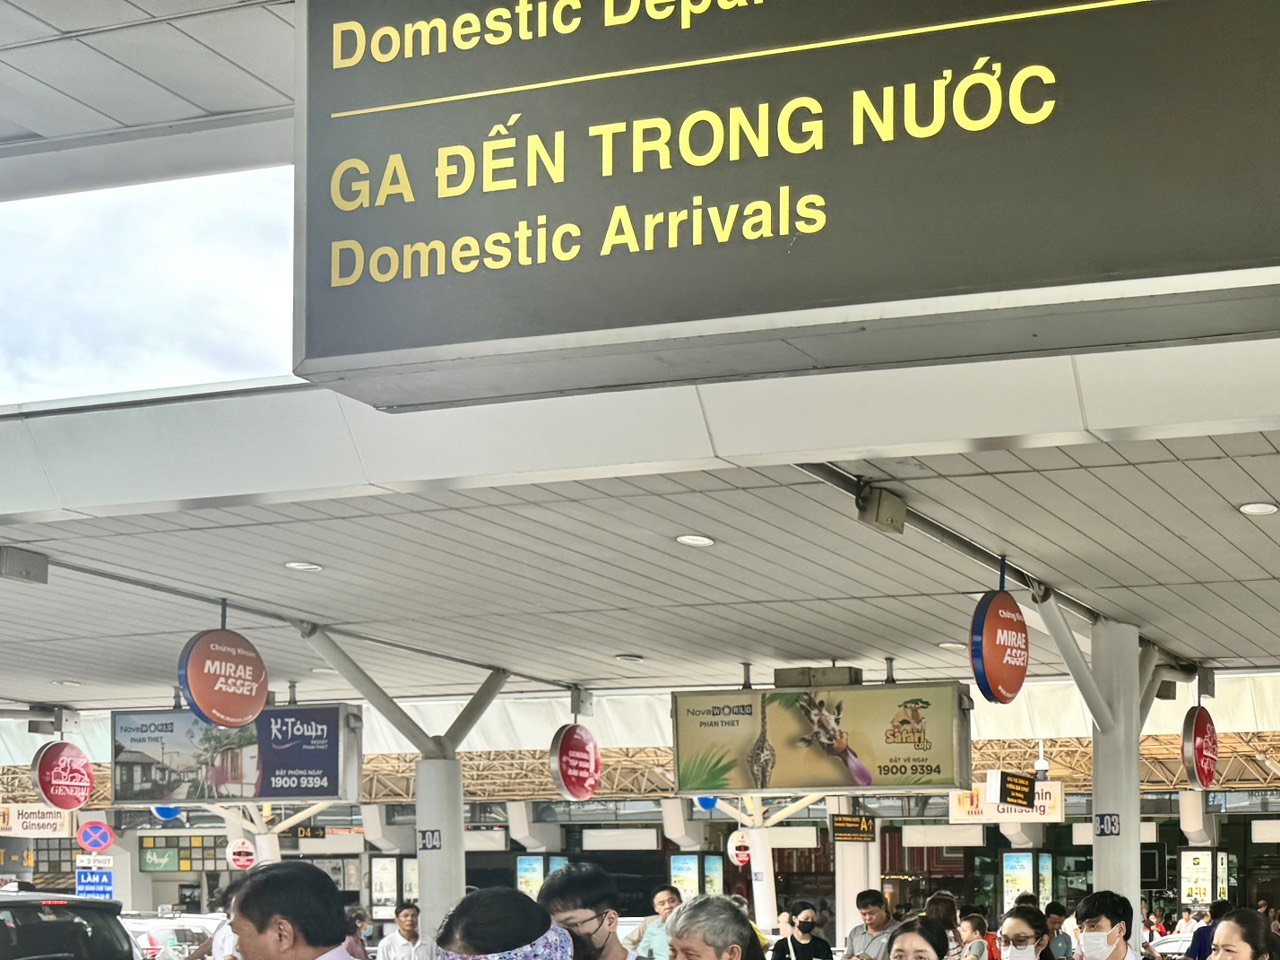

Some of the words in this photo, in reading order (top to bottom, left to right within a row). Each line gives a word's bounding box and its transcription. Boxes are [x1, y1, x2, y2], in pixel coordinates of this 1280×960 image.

[332, 0, 582, 70] Domestic
[330, 153, 415, 212] GA
[435, 113, 565, 199] ĐẾN
[588, 97, 824, 177] TRONG
[852, 57, 1056, 145] NƯỚC
[331, 215, 582, 288] Domestic
[600, 186, 828, 257] Arrivals
[996, 629, 1026, 648] MIRAE
[1003, 648, 1028, 667] ASSET
[203, 660, 253, 680] MIRAE
[214, 677, 259, 697] ASSET
[700, 720, 719, 728] PHAN
[720, 719, 740, 727] THIET
[885, 727, 925, 744] Safari
[877, 764, 907, 775] 1900
[911, 764, 941, 775] 9394
[271, 777, 298, 788] 1900
[300, 776, 328, 788] 9394
[17, 810, 62, 820] Homtamin
[21, 821, 58, 832] Ginseng
